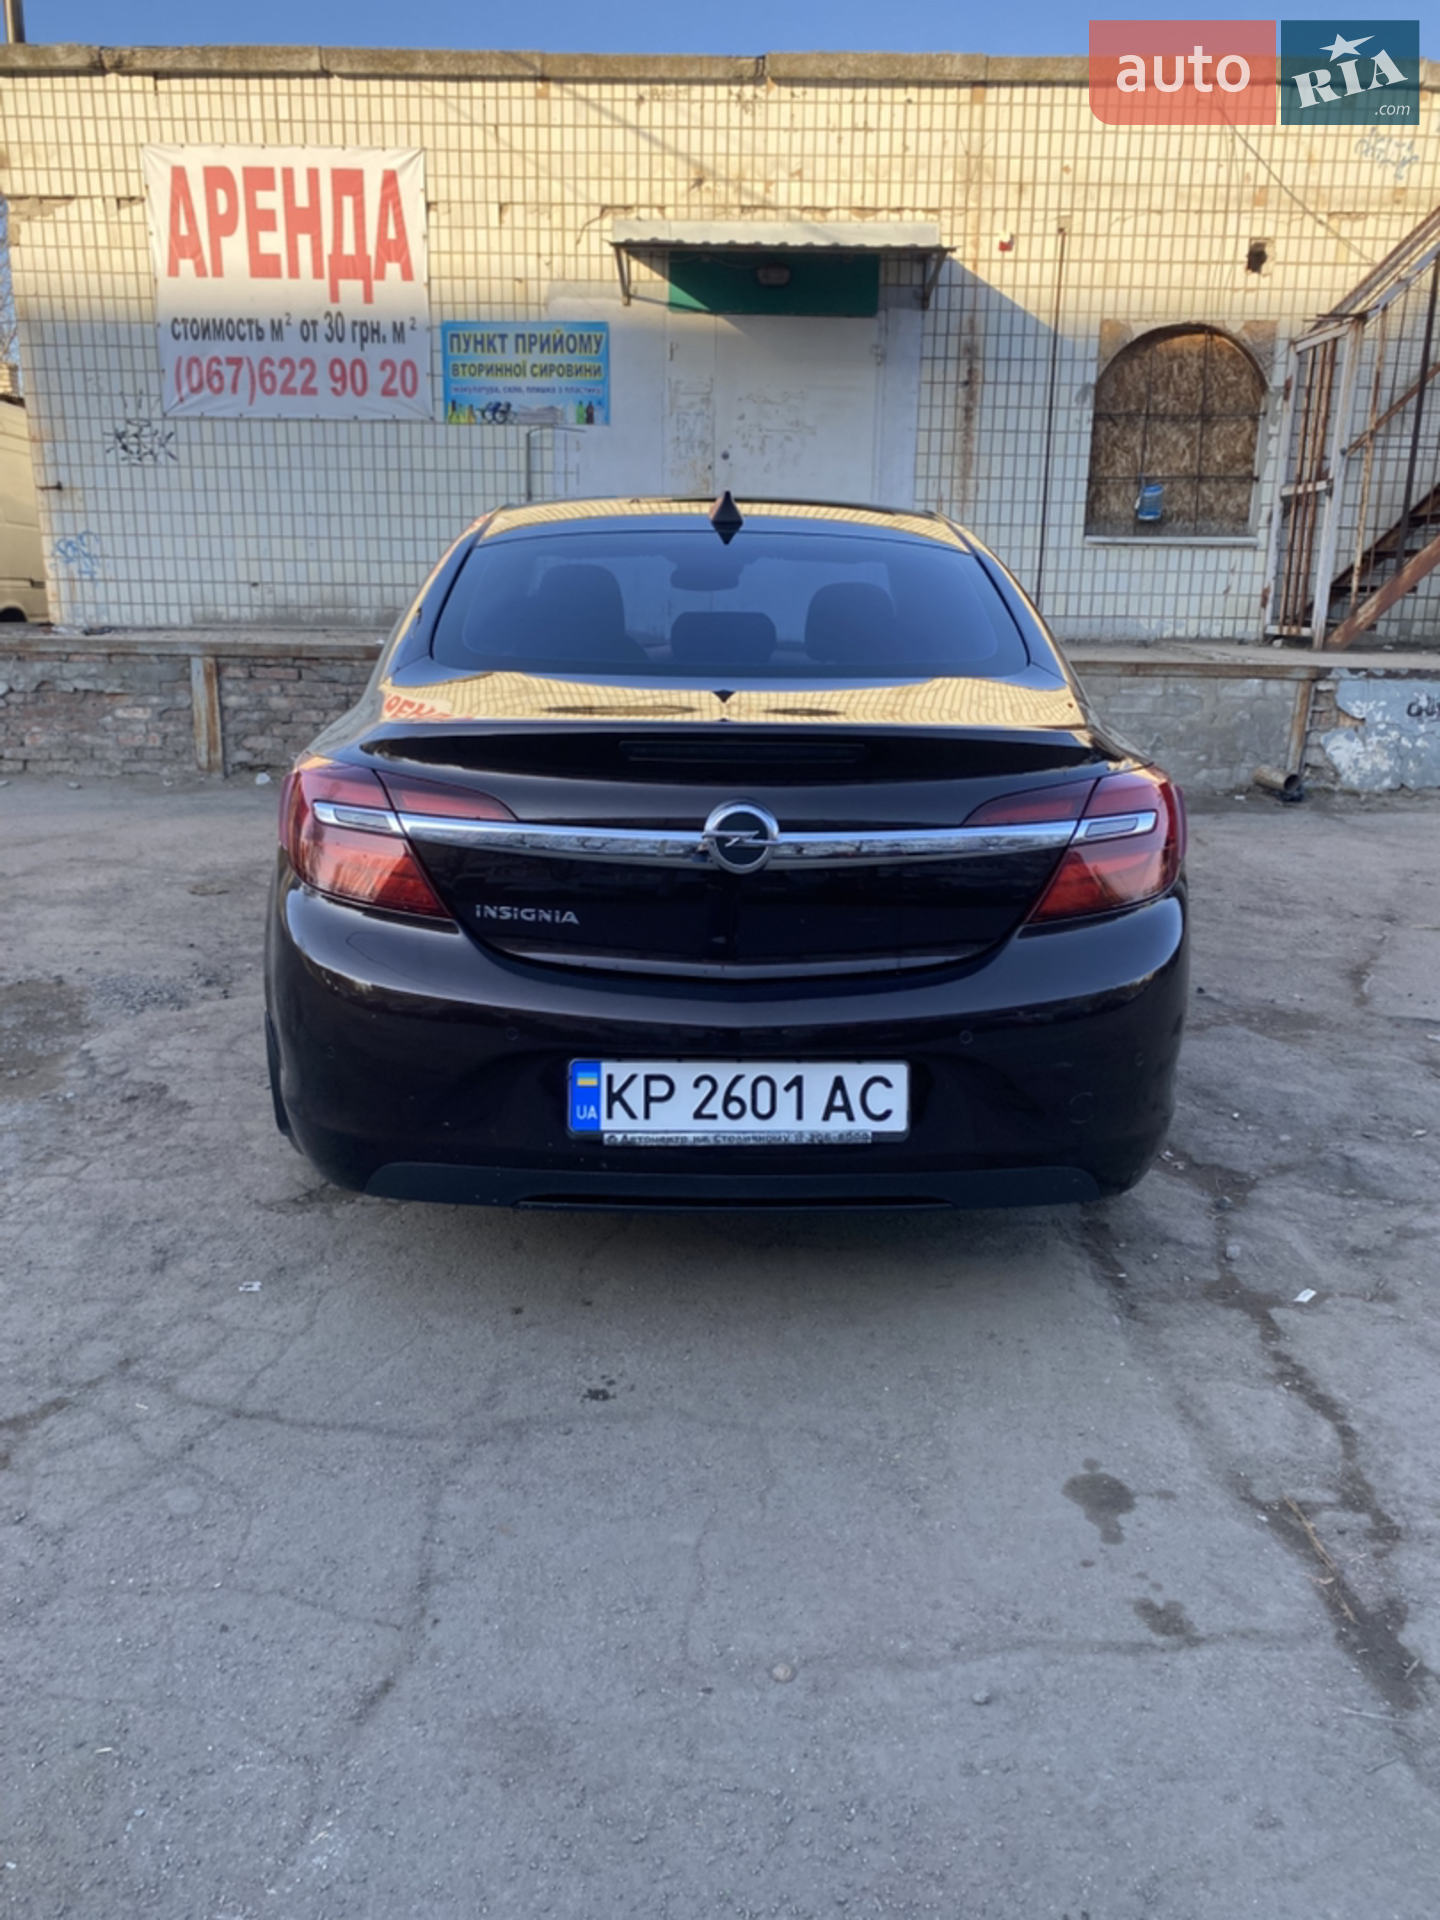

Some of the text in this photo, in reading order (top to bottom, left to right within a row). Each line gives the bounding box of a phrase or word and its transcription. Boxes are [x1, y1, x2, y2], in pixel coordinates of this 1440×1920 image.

[167, 165, 414, 304] АРЕНДА
[300, 319, 318, 342] от
[324, 311, 345, 343] 30
[351, 320, 387, 351] грн.
[449, 327, 603, 354] ПУНКТ ПРИЙОМУ
[175, 355, 418, 406] (067)622 90 20
[451, 360, 602, 378] ВТОРИННОЇ СИРОВИНИ
[576, 1105, 598, 1119] UA
[605, 1073, 894, 1122] KP 2601 AC
